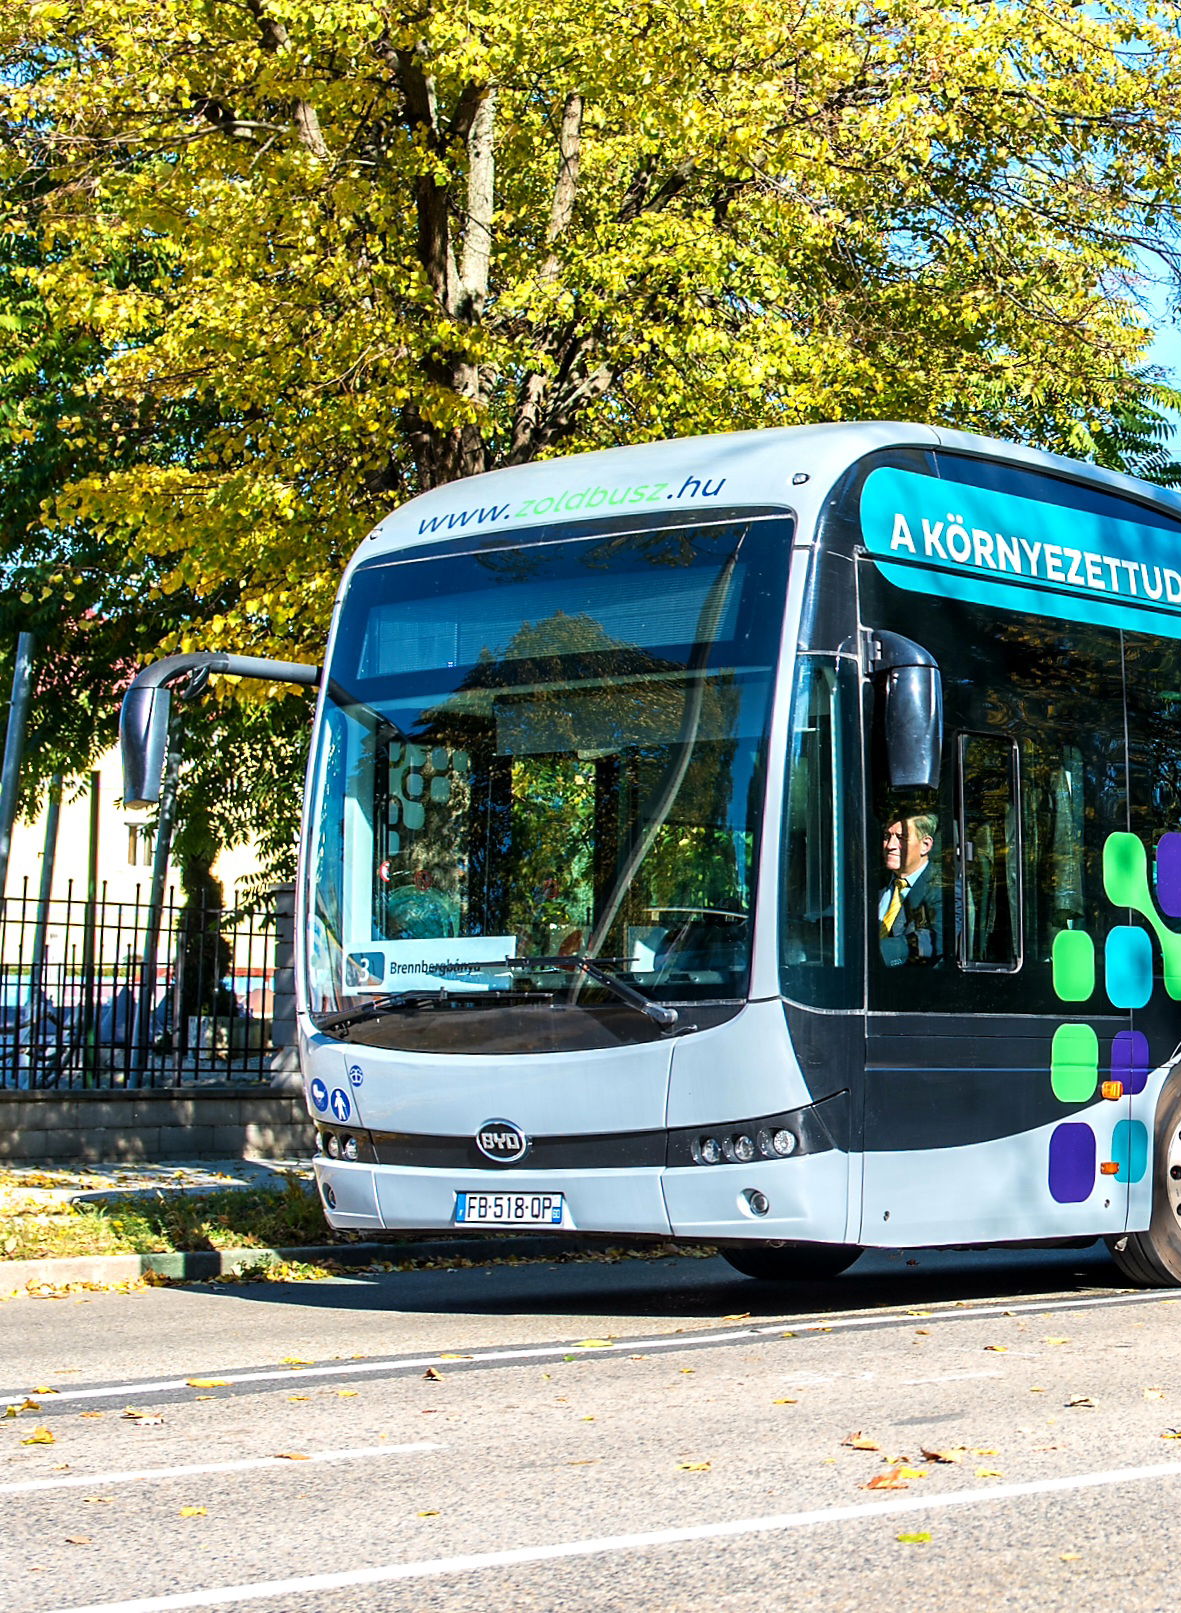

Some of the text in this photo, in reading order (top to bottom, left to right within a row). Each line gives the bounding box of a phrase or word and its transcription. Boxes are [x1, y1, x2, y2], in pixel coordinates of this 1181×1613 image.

[418, 475, 727, 534] www.zoldbusz.hu
[890, 513, 916, 553] A
[358, 957, 370, 983] 3
[481, 1132, 520, 1150] BYD
